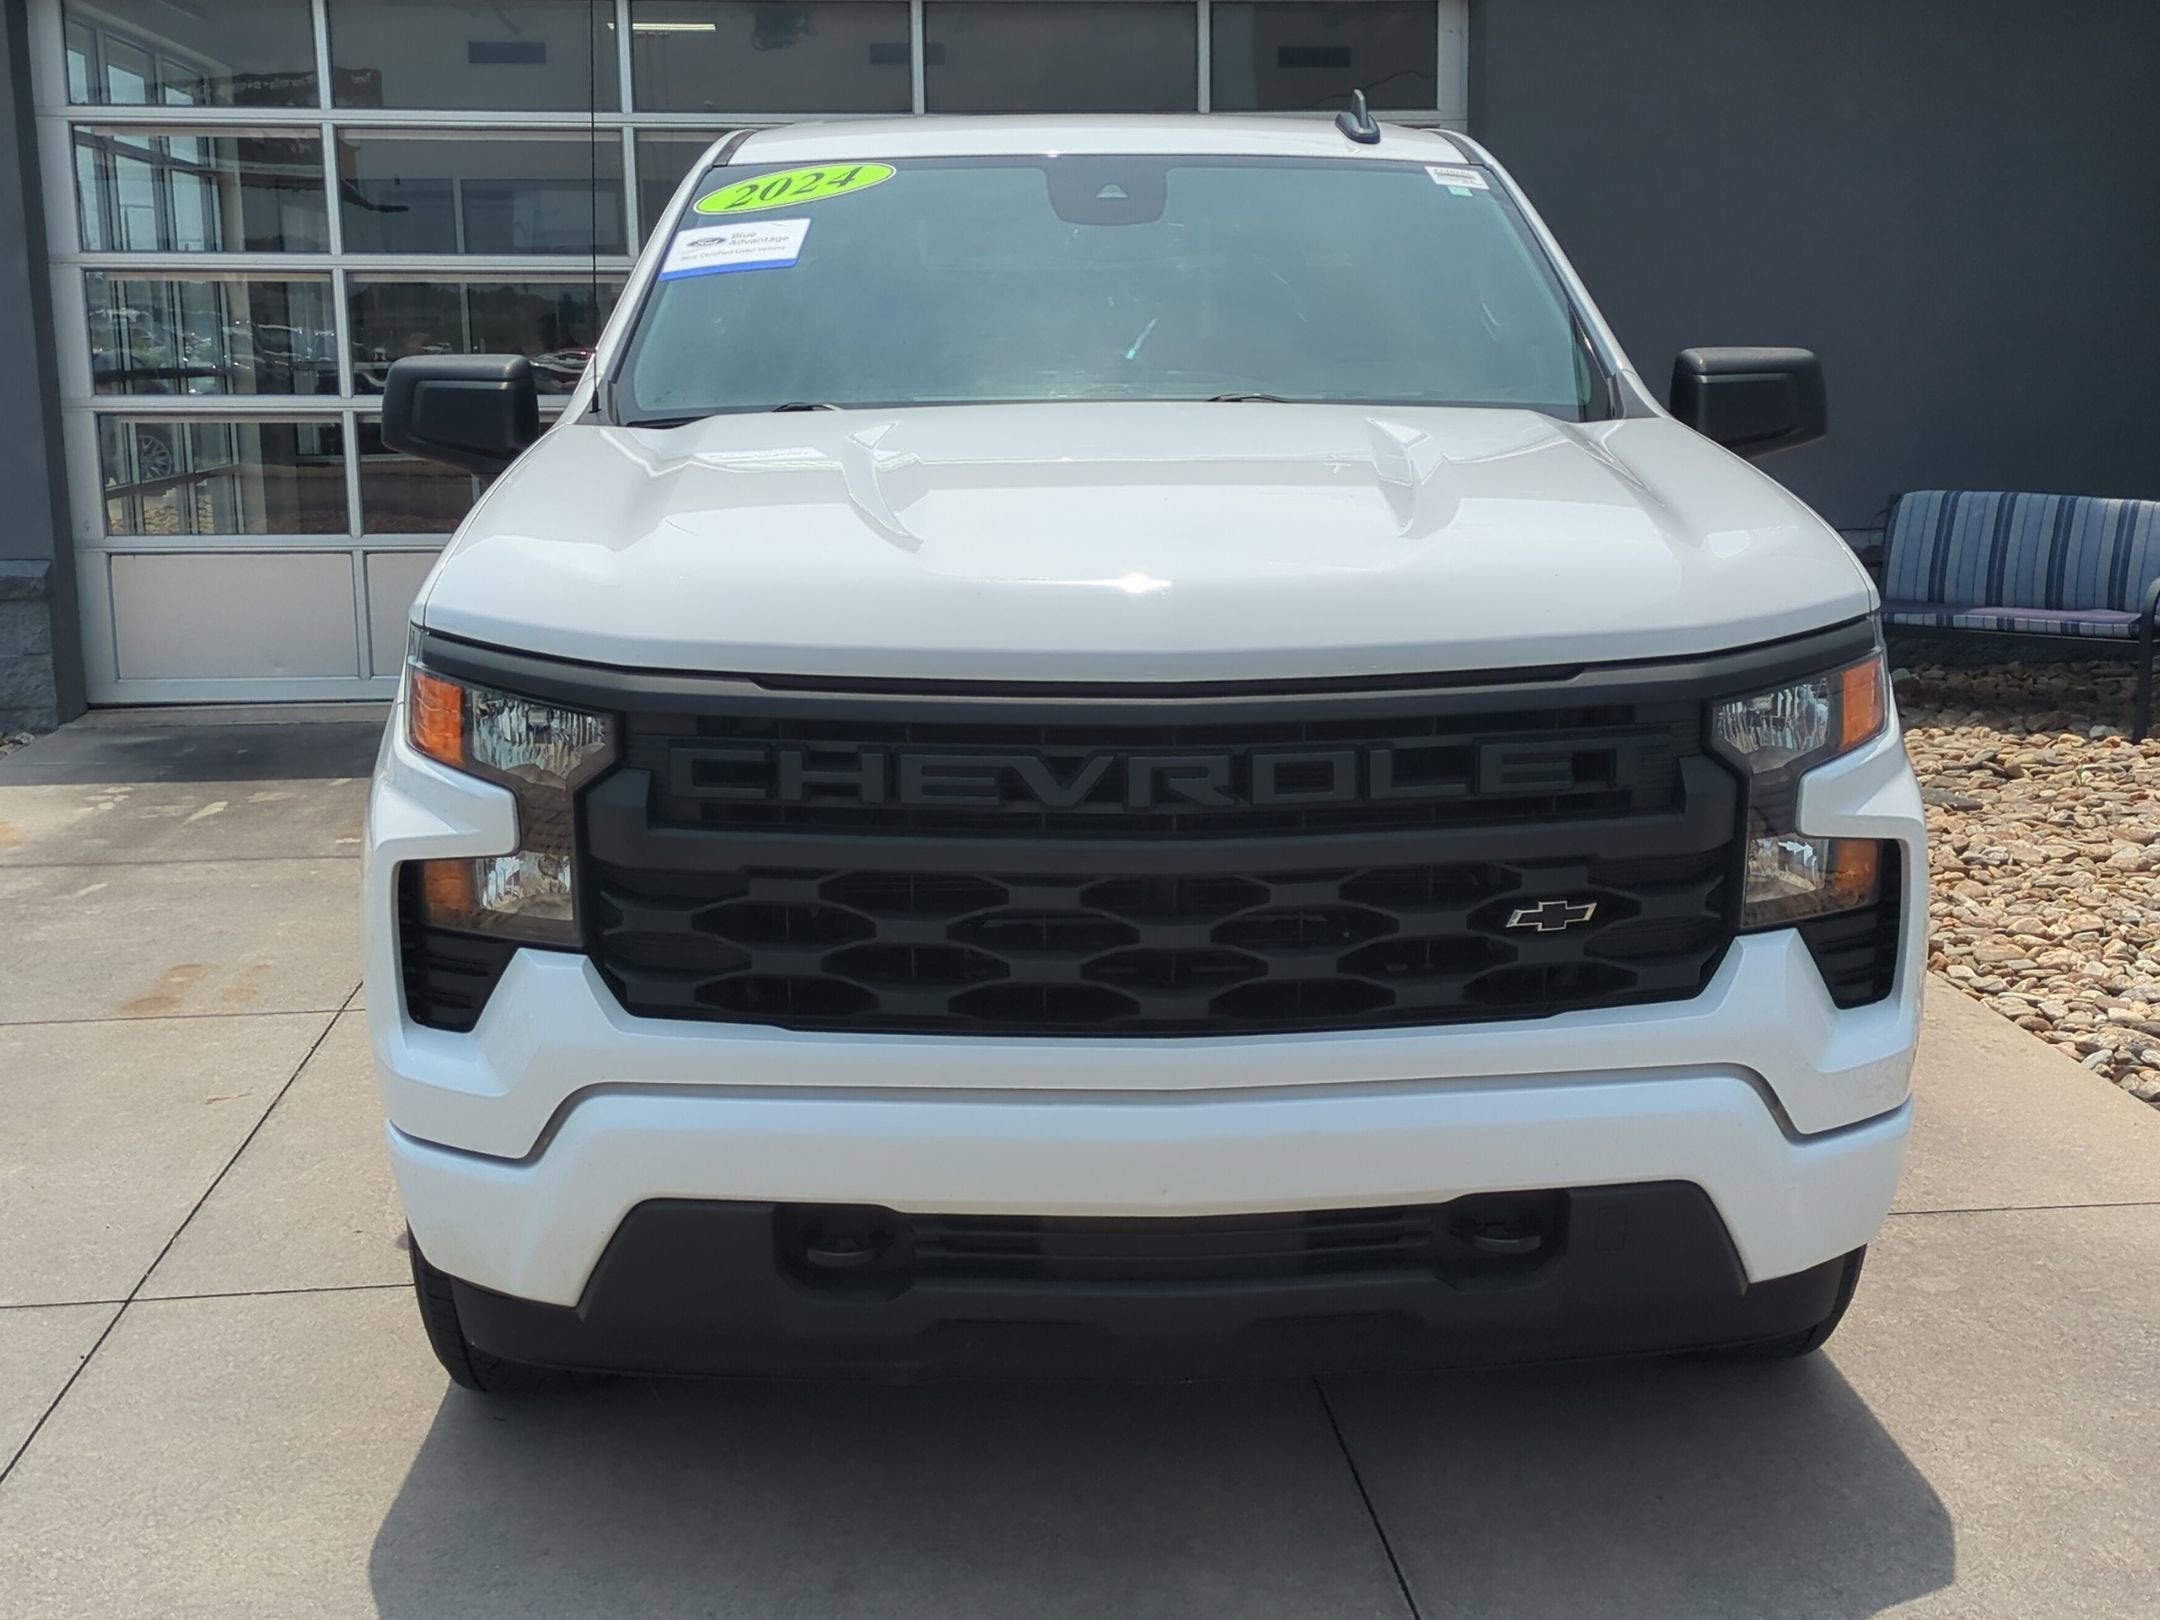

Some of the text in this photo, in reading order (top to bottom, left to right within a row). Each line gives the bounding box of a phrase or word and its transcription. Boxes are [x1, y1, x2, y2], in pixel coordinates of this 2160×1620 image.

[723, 166, 863, 210] 2024
[728, 235, 790, 246] Advantage
[732, 231, 757, 239] Blue
[670, 738, 1668, 806] CHEVROLET
